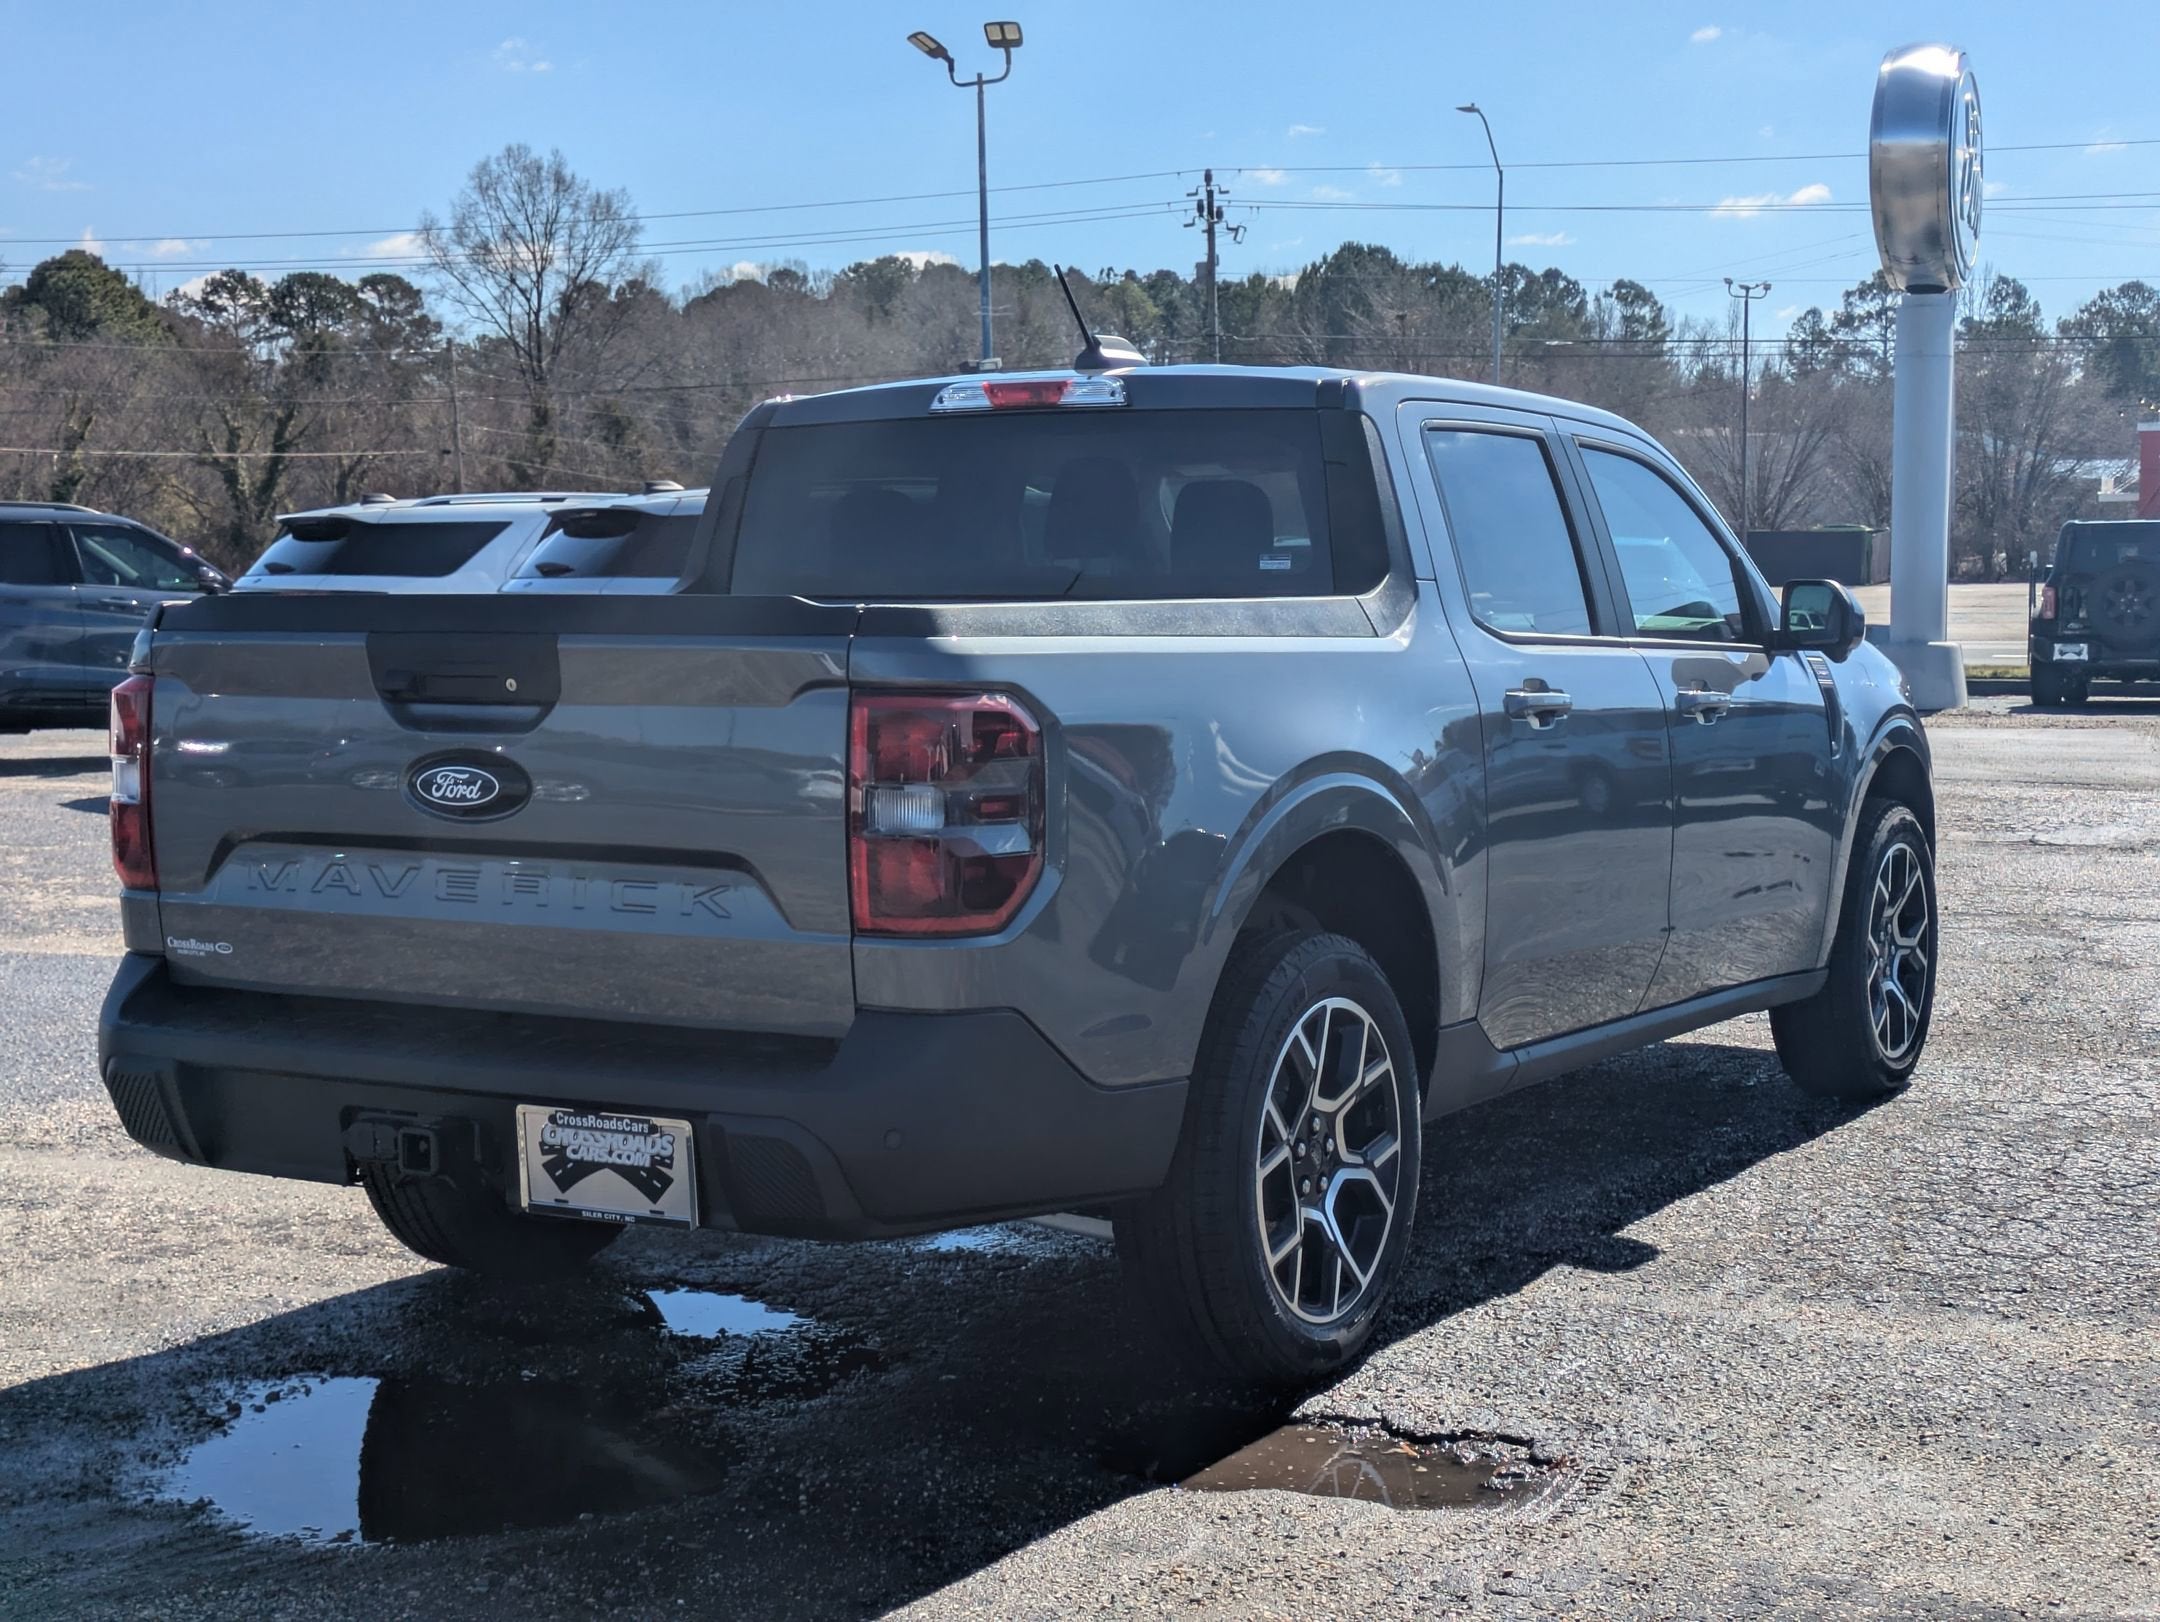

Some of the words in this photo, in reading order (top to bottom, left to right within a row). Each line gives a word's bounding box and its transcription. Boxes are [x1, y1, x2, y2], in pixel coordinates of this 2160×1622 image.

[431, 771, 482, 799] Ford
[247, 861, 733, 919] MAVERICK
[556, 1111, 649, 1133] CrossRoadsCars
